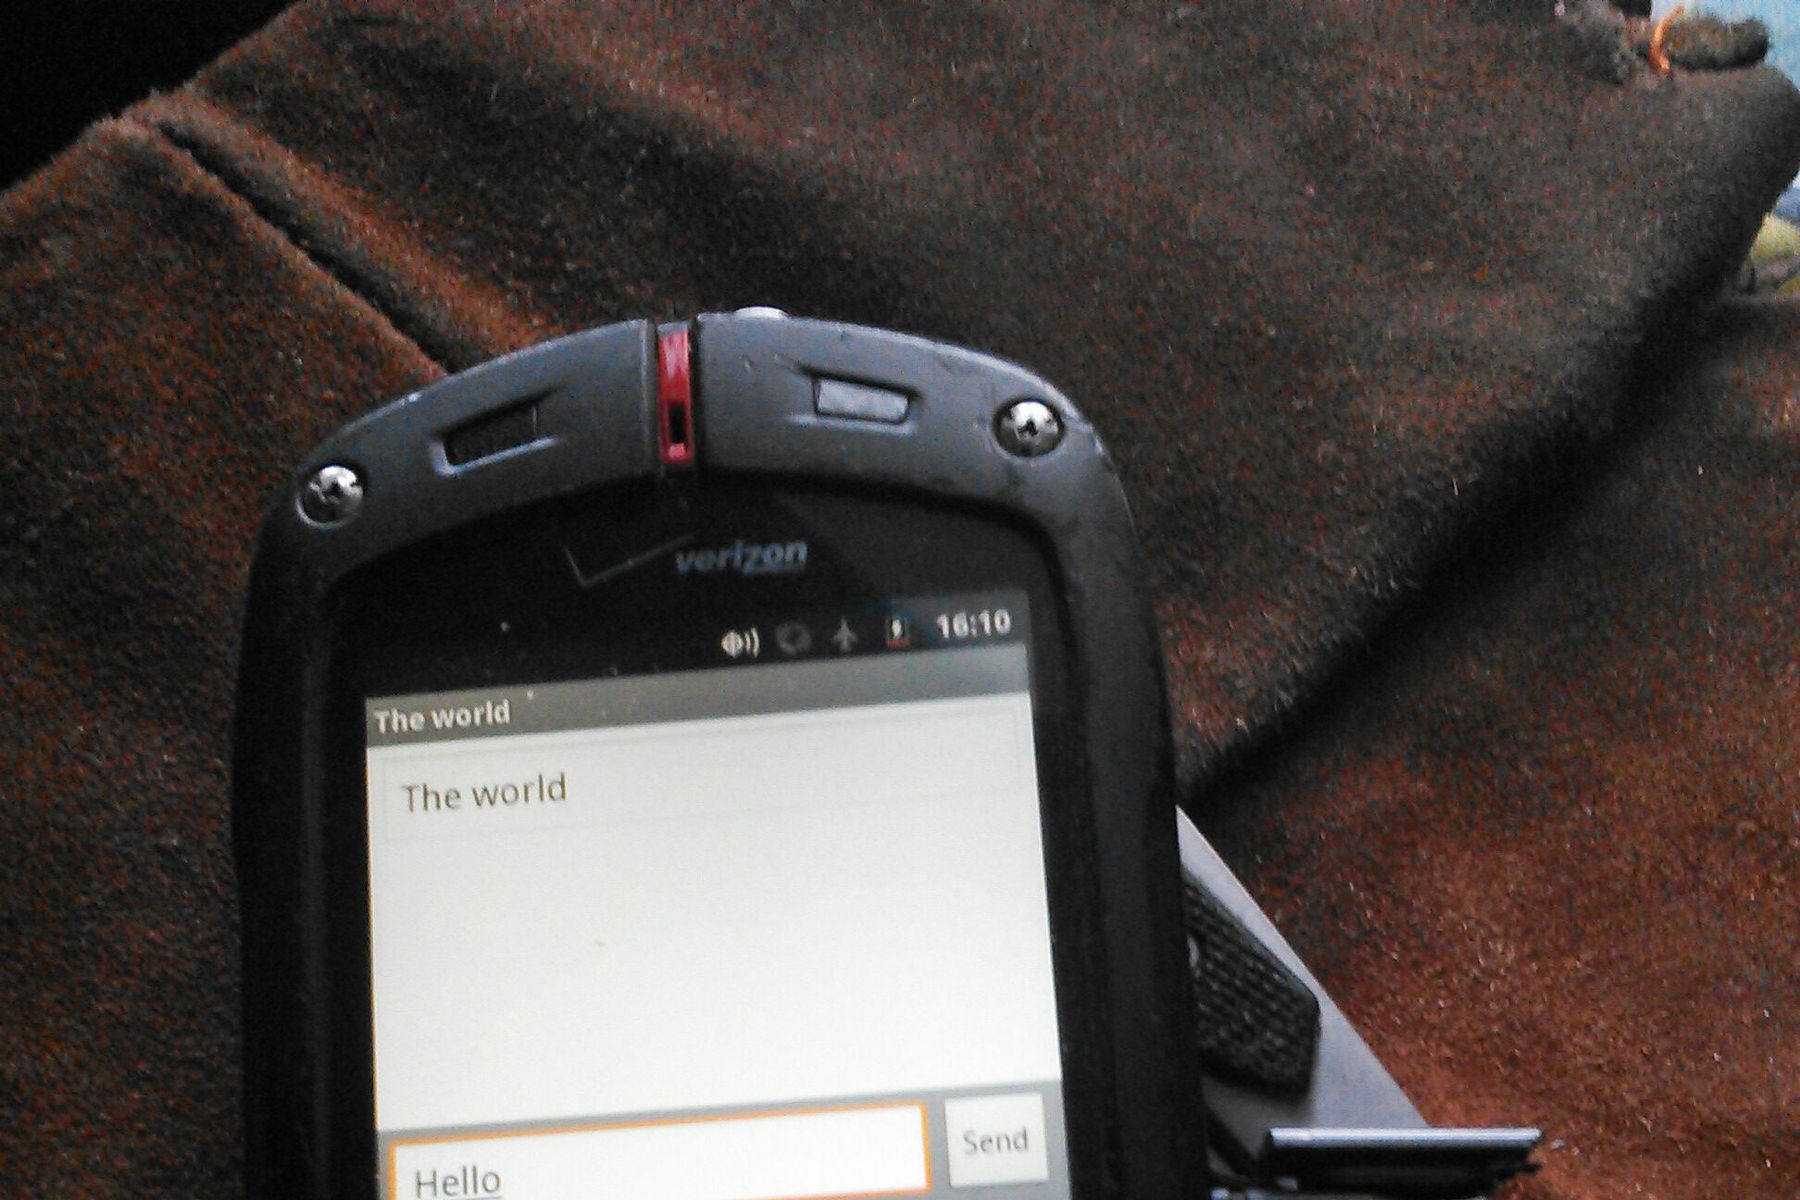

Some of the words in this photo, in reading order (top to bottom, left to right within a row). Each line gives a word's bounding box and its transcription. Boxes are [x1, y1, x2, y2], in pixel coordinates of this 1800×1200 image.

[675, 540, 809, 576] verizon
[936, 608, 1012, 640] 16:10
[374, 708, 426, 735] The
[430, 699, 511, 730] world
[402, 782, 462, 814] The
[471, 771, 567, 808] world
[963, 1125, 1029, 1155] Send
[415, 1165, 501, 1199] Hello
